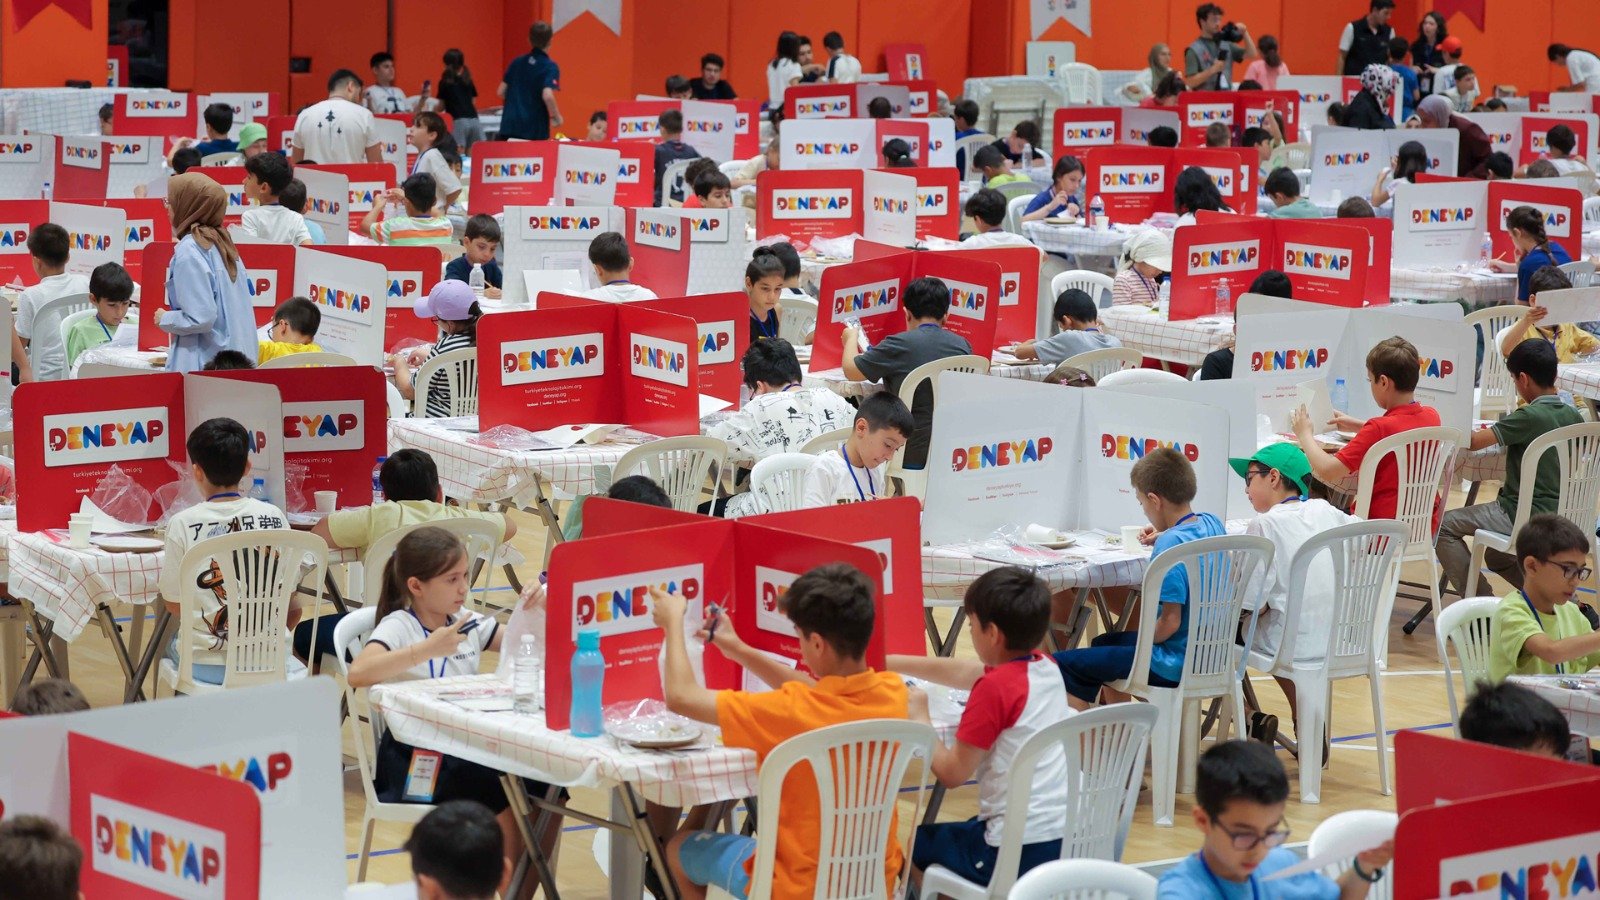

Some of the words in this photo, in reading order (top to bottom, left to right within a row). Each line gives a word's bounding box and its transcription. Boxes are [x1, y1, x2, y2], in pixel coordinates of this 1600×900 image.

[132, 101, 181, 110] DENEYAP
[798, 102, 847, 113] DENEYAP
[1191, 110, 1232, 120] DENEYAP
[687, 120, 723, 133] DENEYAP
[1067, 128, 1113, 139] DENEYAP
[66, 146, 98, 159] DENEYAP
[795, 143, 859, 155] DENEYAP
[1325, 152, 1370, 166] DENEYAP
[484, 163, 541, 177] DENEYAP
[565, 169, 607, 185] DENEYAP
[1103, 172, 1160, 186] DENEYAP
[776, 196, 849, 210] DENEYAP
[873, 196, 908, 214] DENEYAP
[529, 216, 600, 230] DENEYAP
[1412, 207, 1474, 224] DENEYAP
[640, 220, 677, 239] DENEYAP
[69, 232, 111, 251] ENEYAP
[1190, 246, 1257, 268] DENEYAP
[1286, 249, 1349, 271] DENEYAP
[310, 284, 371, 313] DENEYAP
[835, 286, 897, 314] DENEYAP
[503, 344, 598, 373] DENEYAP
[633, 343, 684, 373] DENEYAP
[1251, 348, 1328, 371] DENEYAP
[49, 419, 163, 451] DENEYAP
[952, 437, 1053, 472] DENEYAP
[96, 814, 220, 886] DENEYAP
